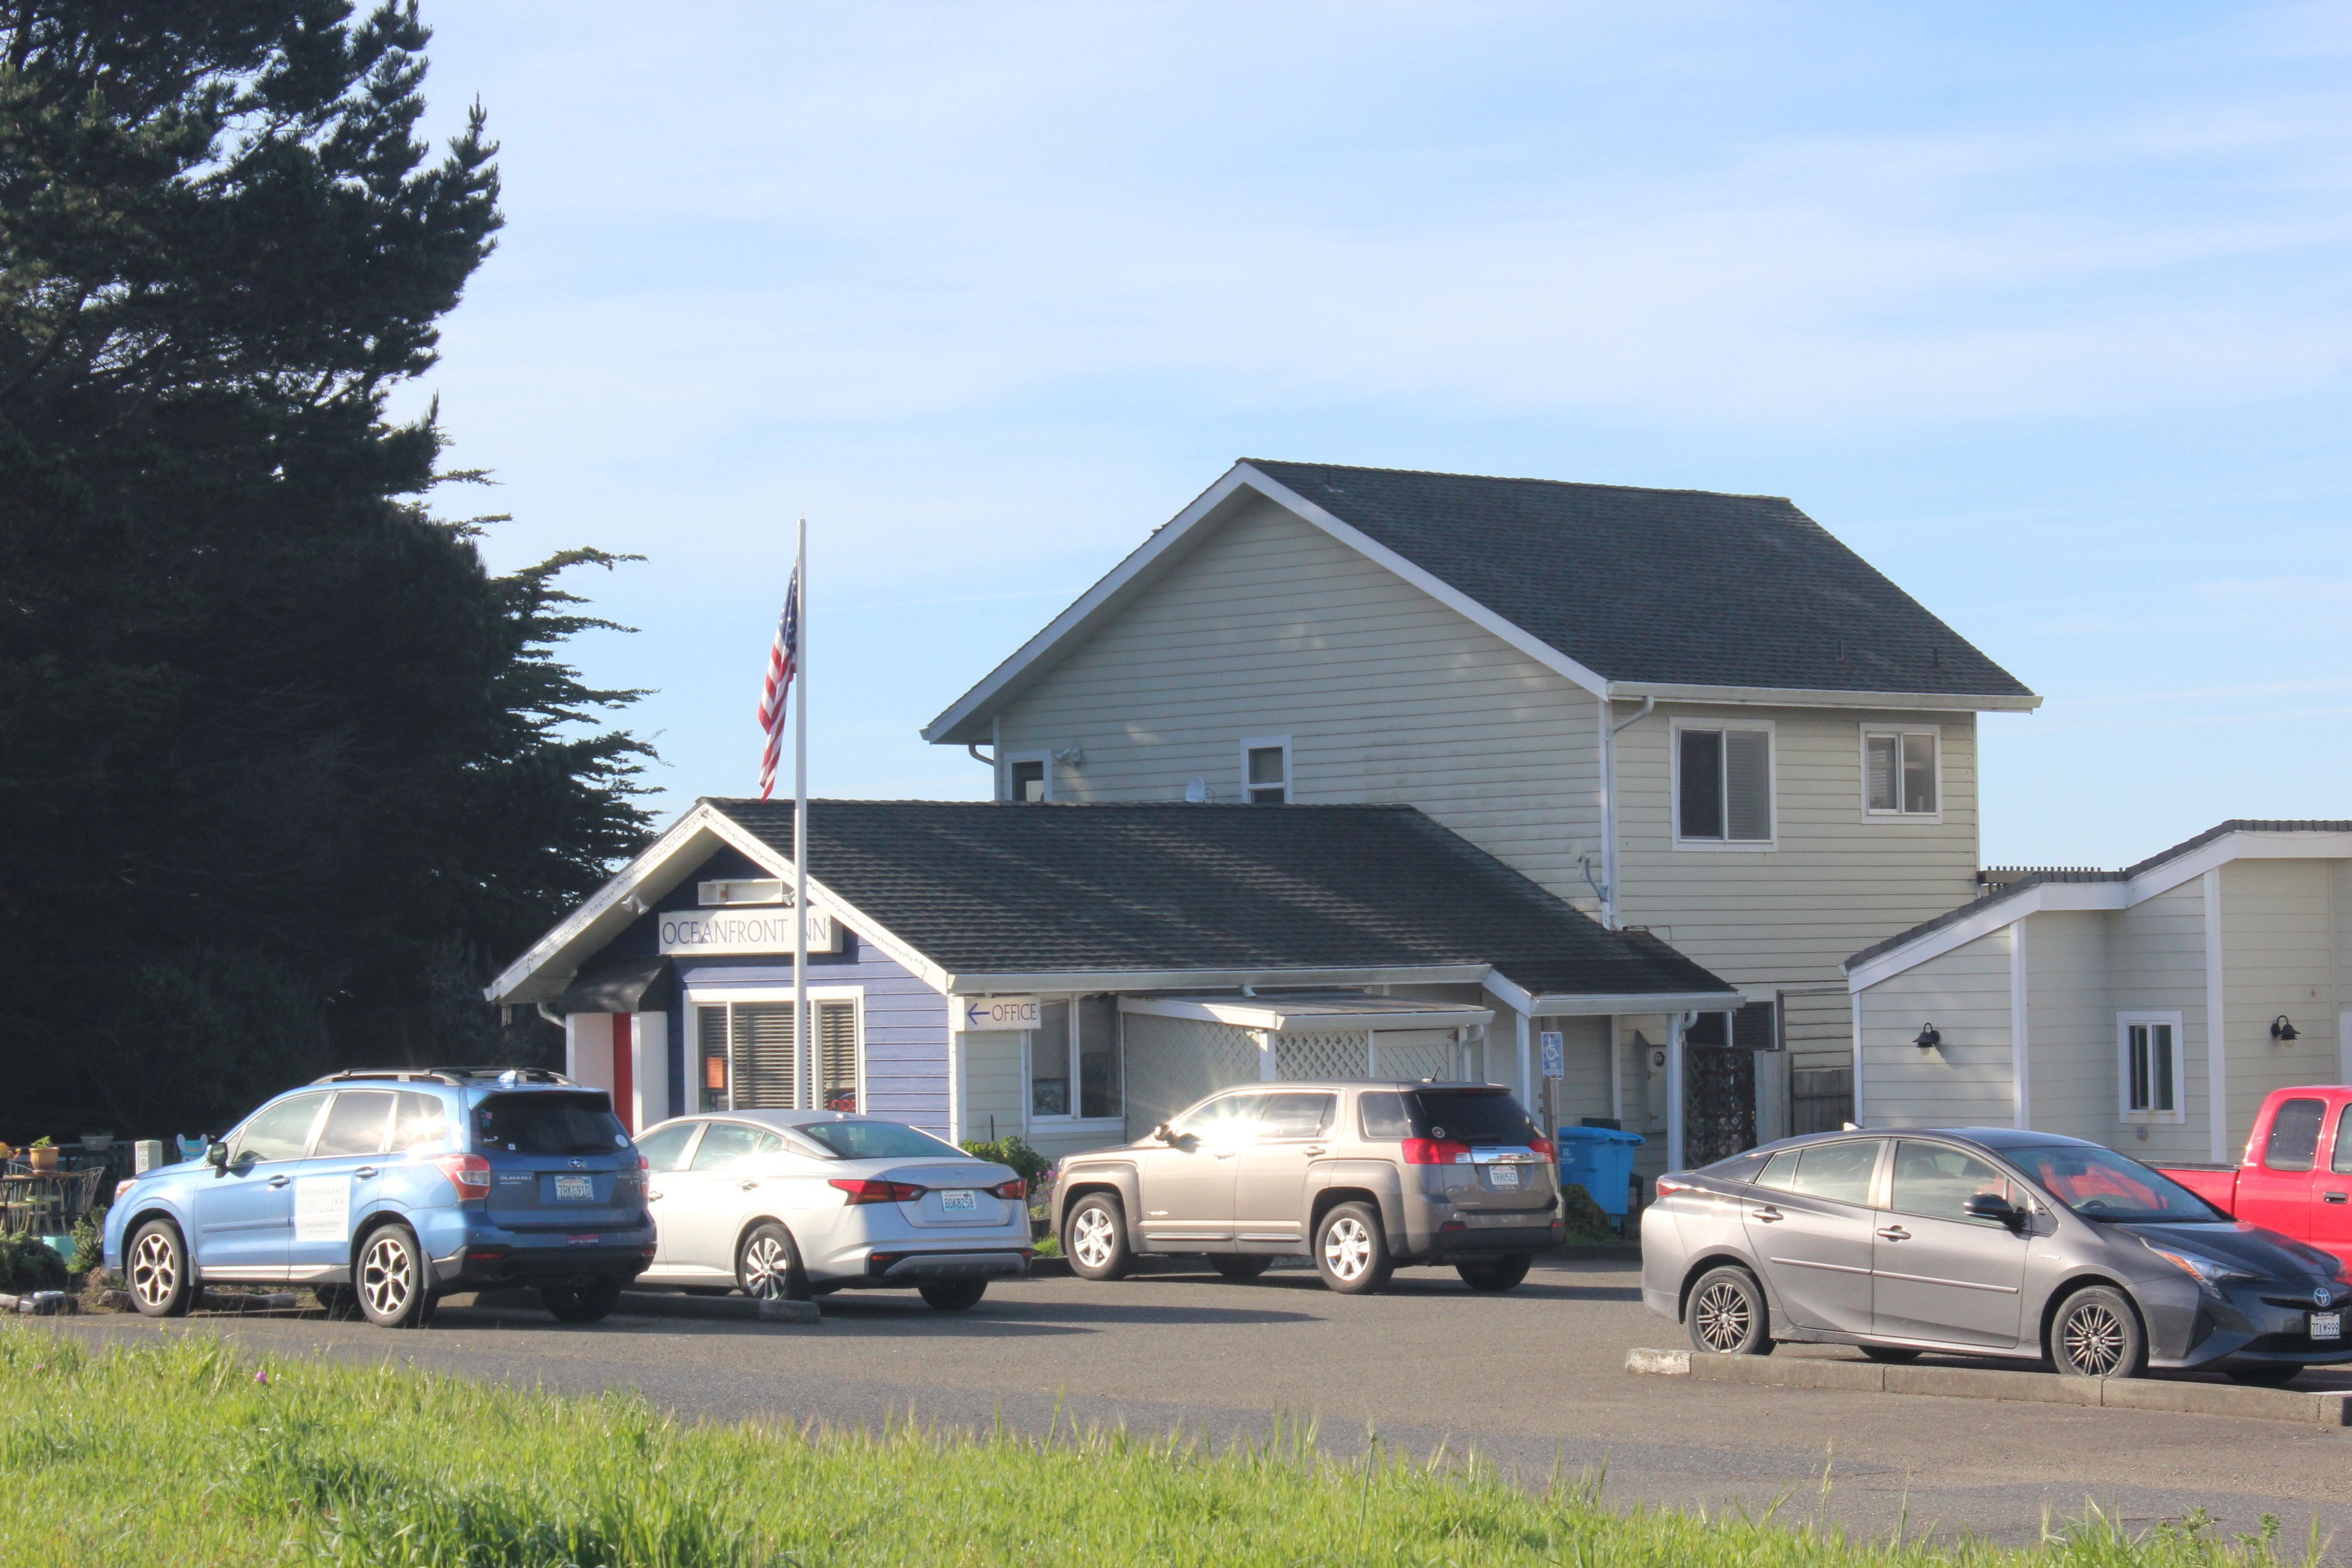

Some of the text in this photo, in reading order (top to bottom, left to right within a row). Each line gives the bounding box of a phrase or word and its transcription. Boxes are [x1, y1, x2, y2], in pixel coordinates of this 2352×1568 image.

[662, 918, 827, 944] OCEANFRONT NN
[992, 1003, 1038, 1021] OFFICE
[300, 1188, 344, 1196] OCEANFRONT
[558, 1185, 590, 1196] 7RKG910
